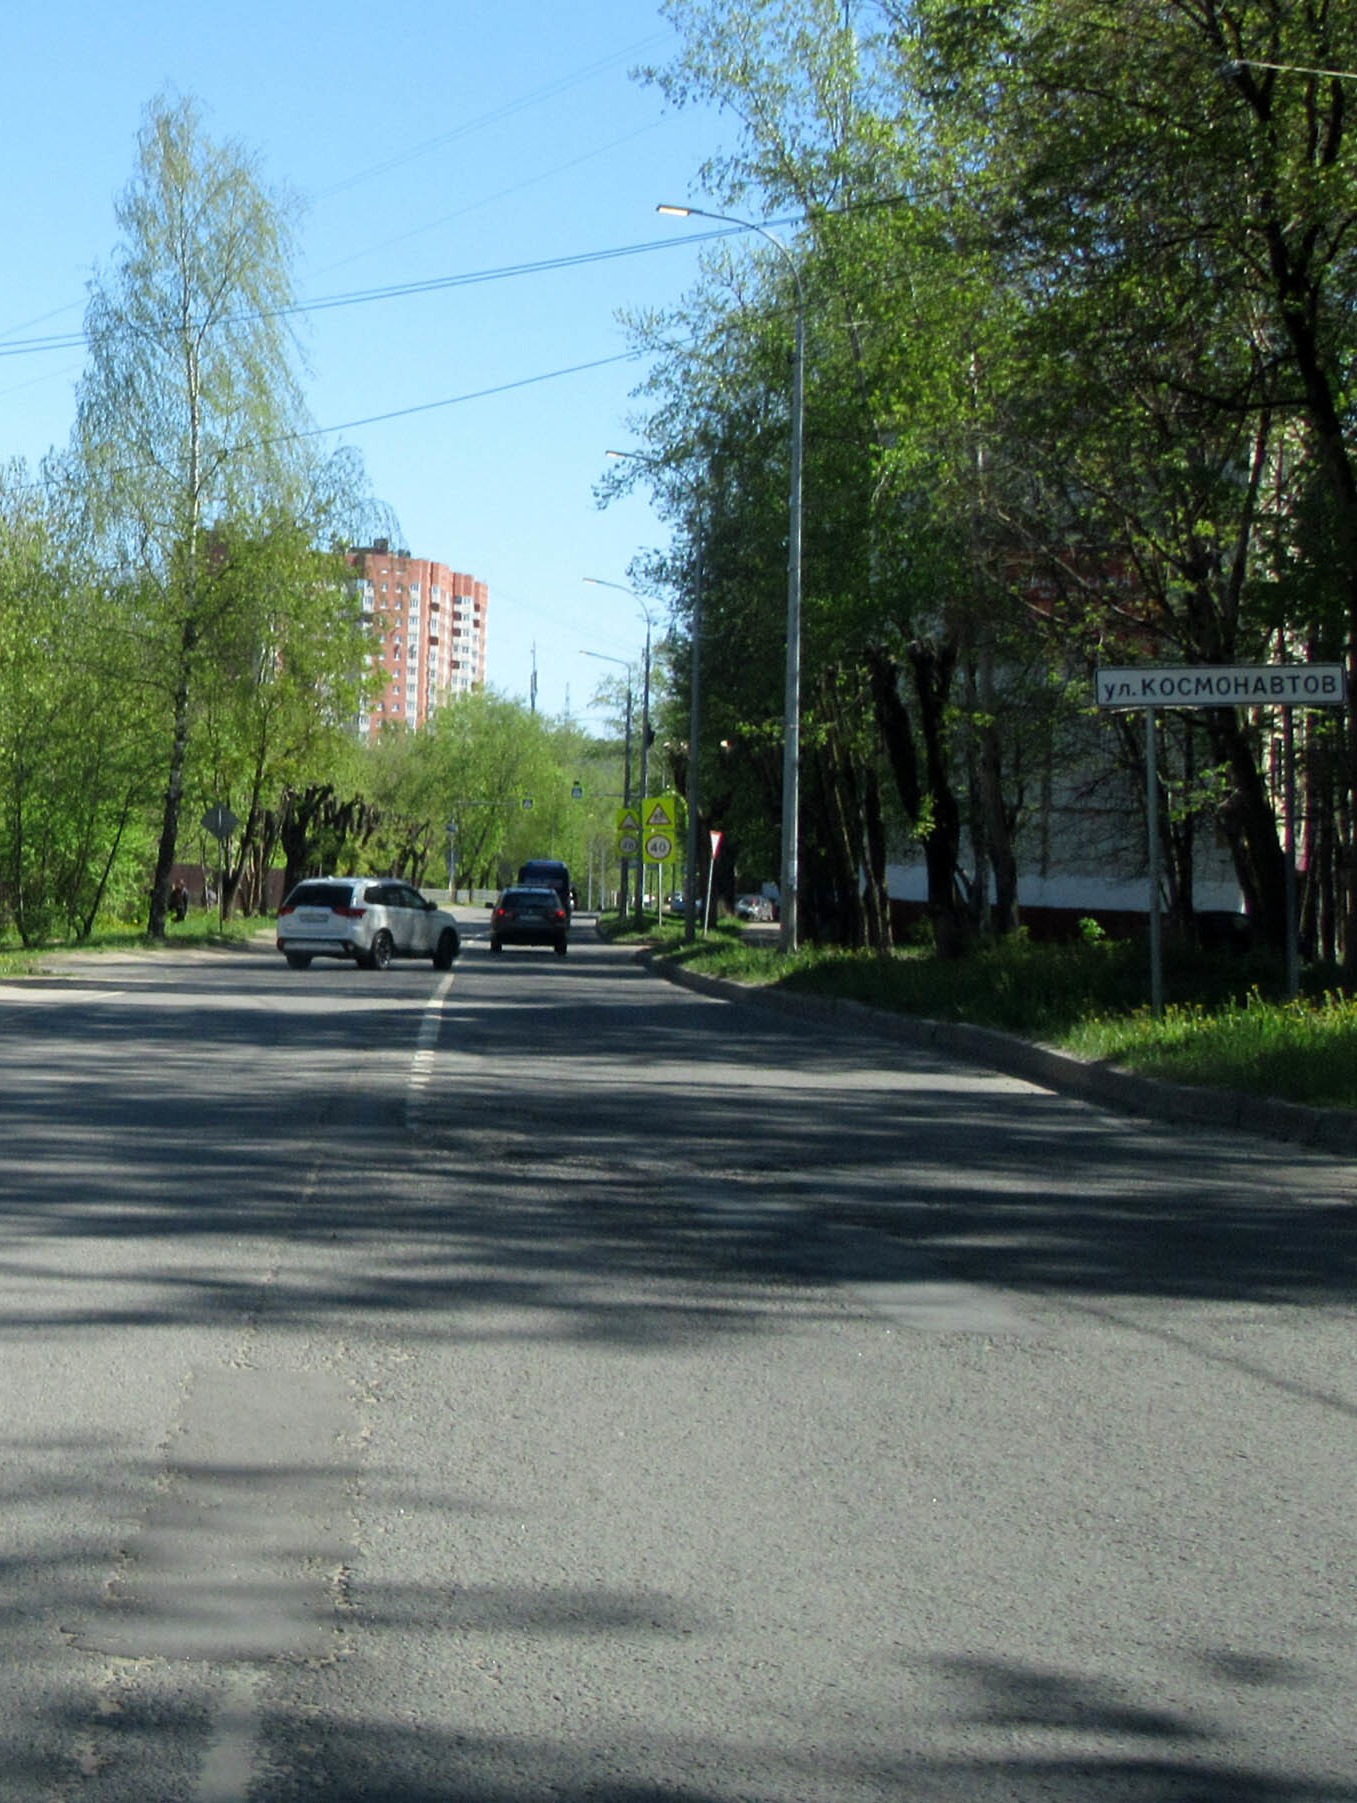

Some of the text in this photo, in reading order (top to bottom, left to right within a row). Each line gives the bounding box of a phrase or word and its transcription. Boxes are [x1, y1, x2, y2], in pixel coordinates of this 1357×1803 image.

[1104, 675, 1337, 700] ул. КОСМОНАВТОВ
[650, 842, 667, 853] 40
